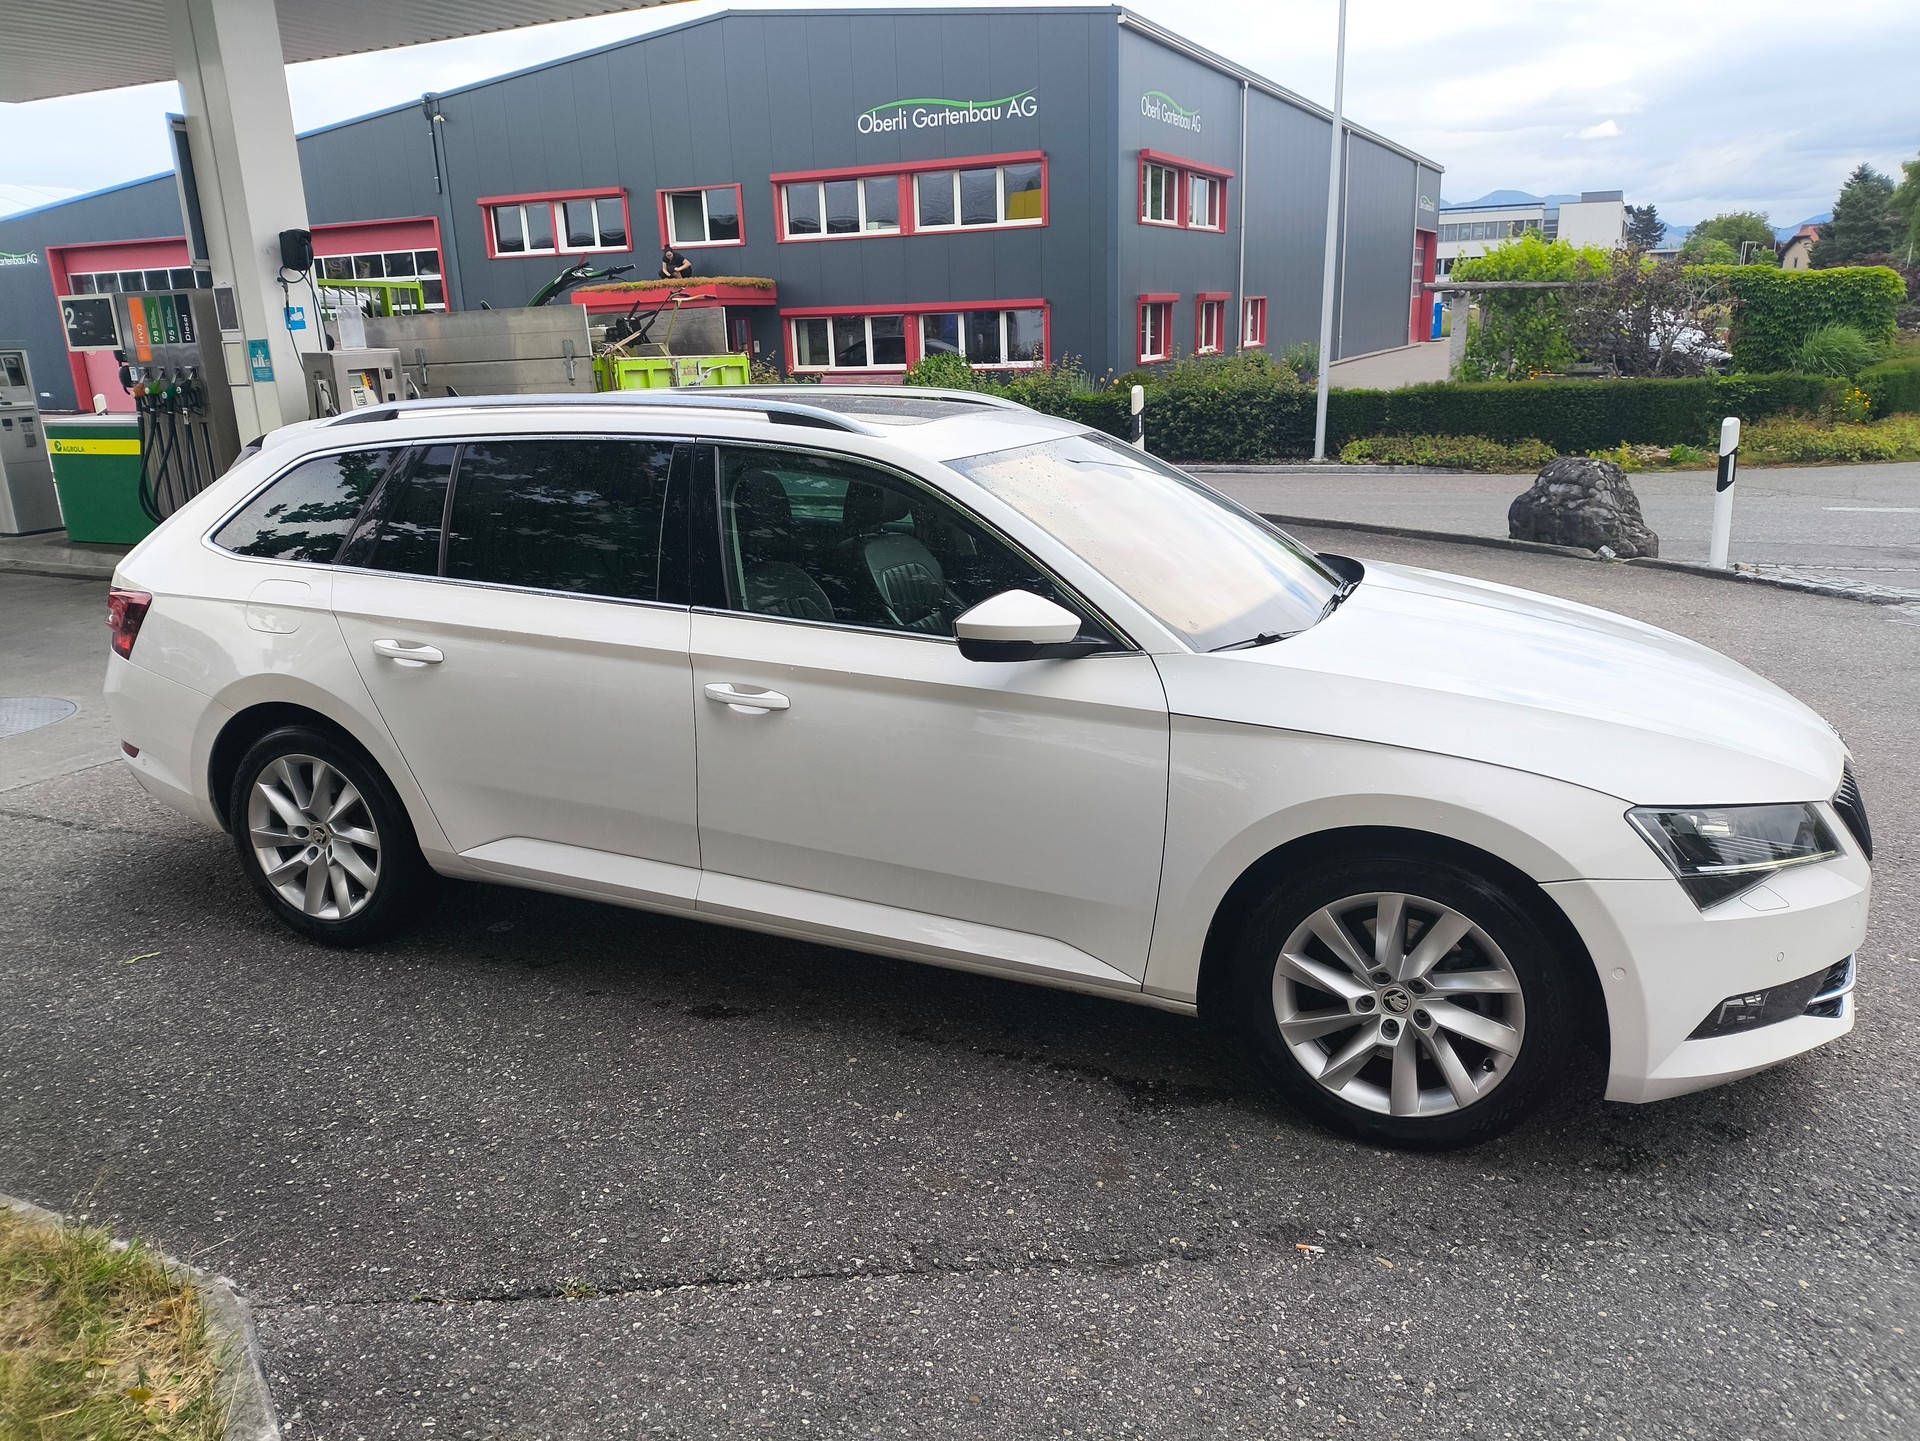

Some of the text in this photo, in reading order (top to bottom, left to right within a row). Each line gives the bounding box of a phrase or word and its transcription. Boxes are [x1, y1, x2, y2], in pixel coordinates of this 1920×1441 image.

[857, 96, 1038, 134] Oberli Gartenbau AG
[1141, 95, 1201, 133] Oberli Gartenbau AG
[26, 253, 38, 264] AG
[64, 307, 77, 329] 2
[181, 314, 192, 341] Diesel
[136, 323, 145, 343] HVO
[152, 330, 160, 342] 98
[168, 329, 176, 341] 95
